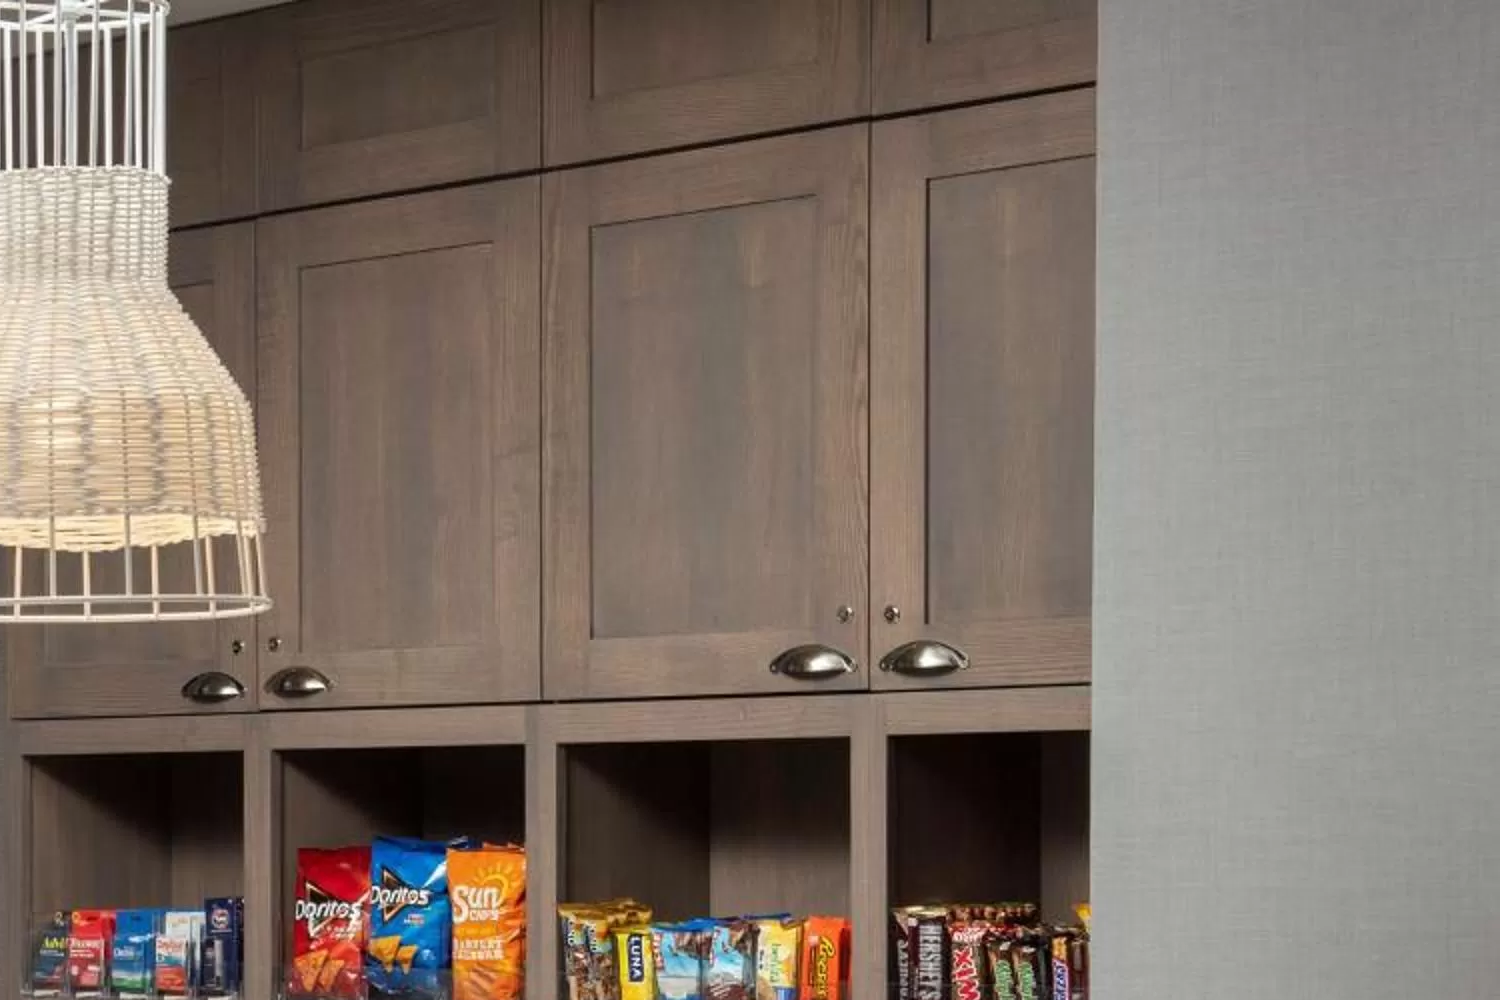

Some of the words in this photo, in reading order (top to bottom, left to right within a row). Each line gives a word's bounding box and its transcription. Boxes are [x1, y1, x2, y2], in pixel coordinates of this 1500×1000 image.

[295, 899, 363, 920] Doritos
[371, 885, 430, 907] Doritos
[452, 886, 498, 925] Sun
[630, 935, 643, 980] LUNA
